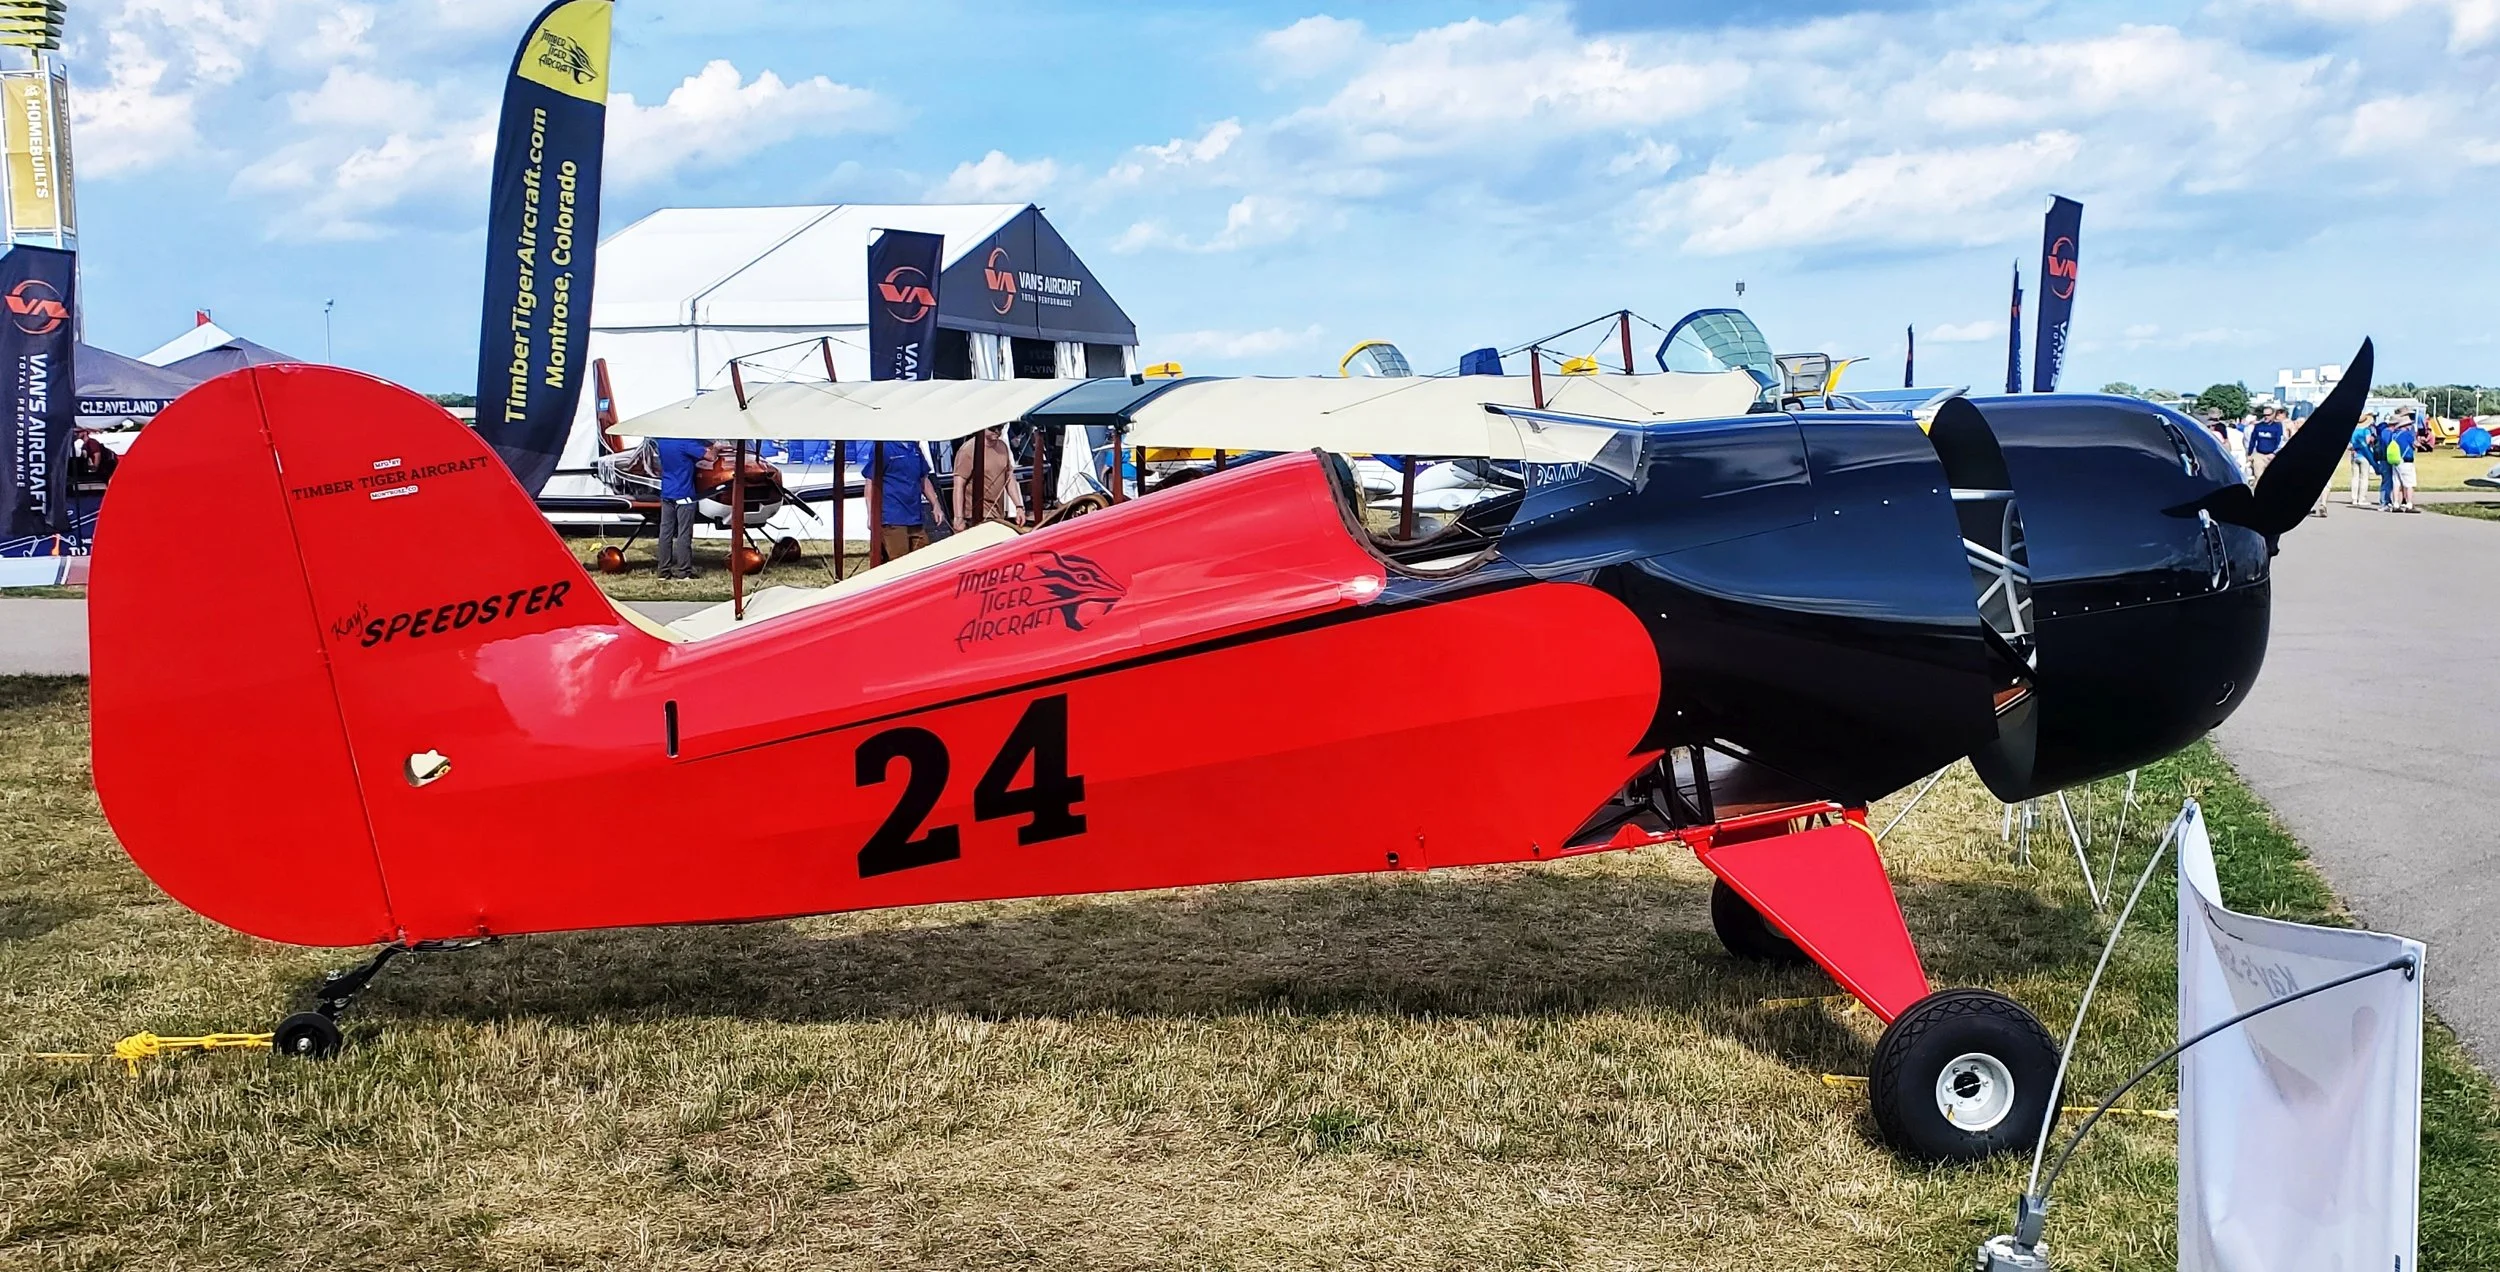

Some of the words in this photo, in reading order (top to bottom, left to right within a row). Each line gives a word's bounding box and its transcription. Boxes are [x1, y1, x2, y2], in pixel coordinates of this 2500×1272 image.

[26, 99, 49, 199] HOMEBUILTS
[551, 160, 577, 266] Colorado
[505, 107, 547, 424] TimberTigerAircraft.com
[1044, 276, 1082, 297] AIRCRAFT
[545, 272, 574, 389] Montrose,
[18, 355, 27, 391] TOTAL
[28, 353, 48, 413] VAN'S
[80, 400, 158, 414] CLEAVELAND
[16, 398, 26, 488] PERFORMANCE
[28, 415, 47, 515] AIRCRAFT
[292, 479, 355, 501] TIMBER
[358, 470, 408, 489] TIGER
[410, 455, 489, 482] AIRCRAFT
[955, 562, 1025, 600] TIMBER
[980, 586, 1033, 619] TIGER
[331, 600, 369, 641] Kay's
[361, 580, 572, 648] SPEEDSTER
[955, 607, 1055, 653] AIRCRAFT
[854, 692, 1088, 879] 24
